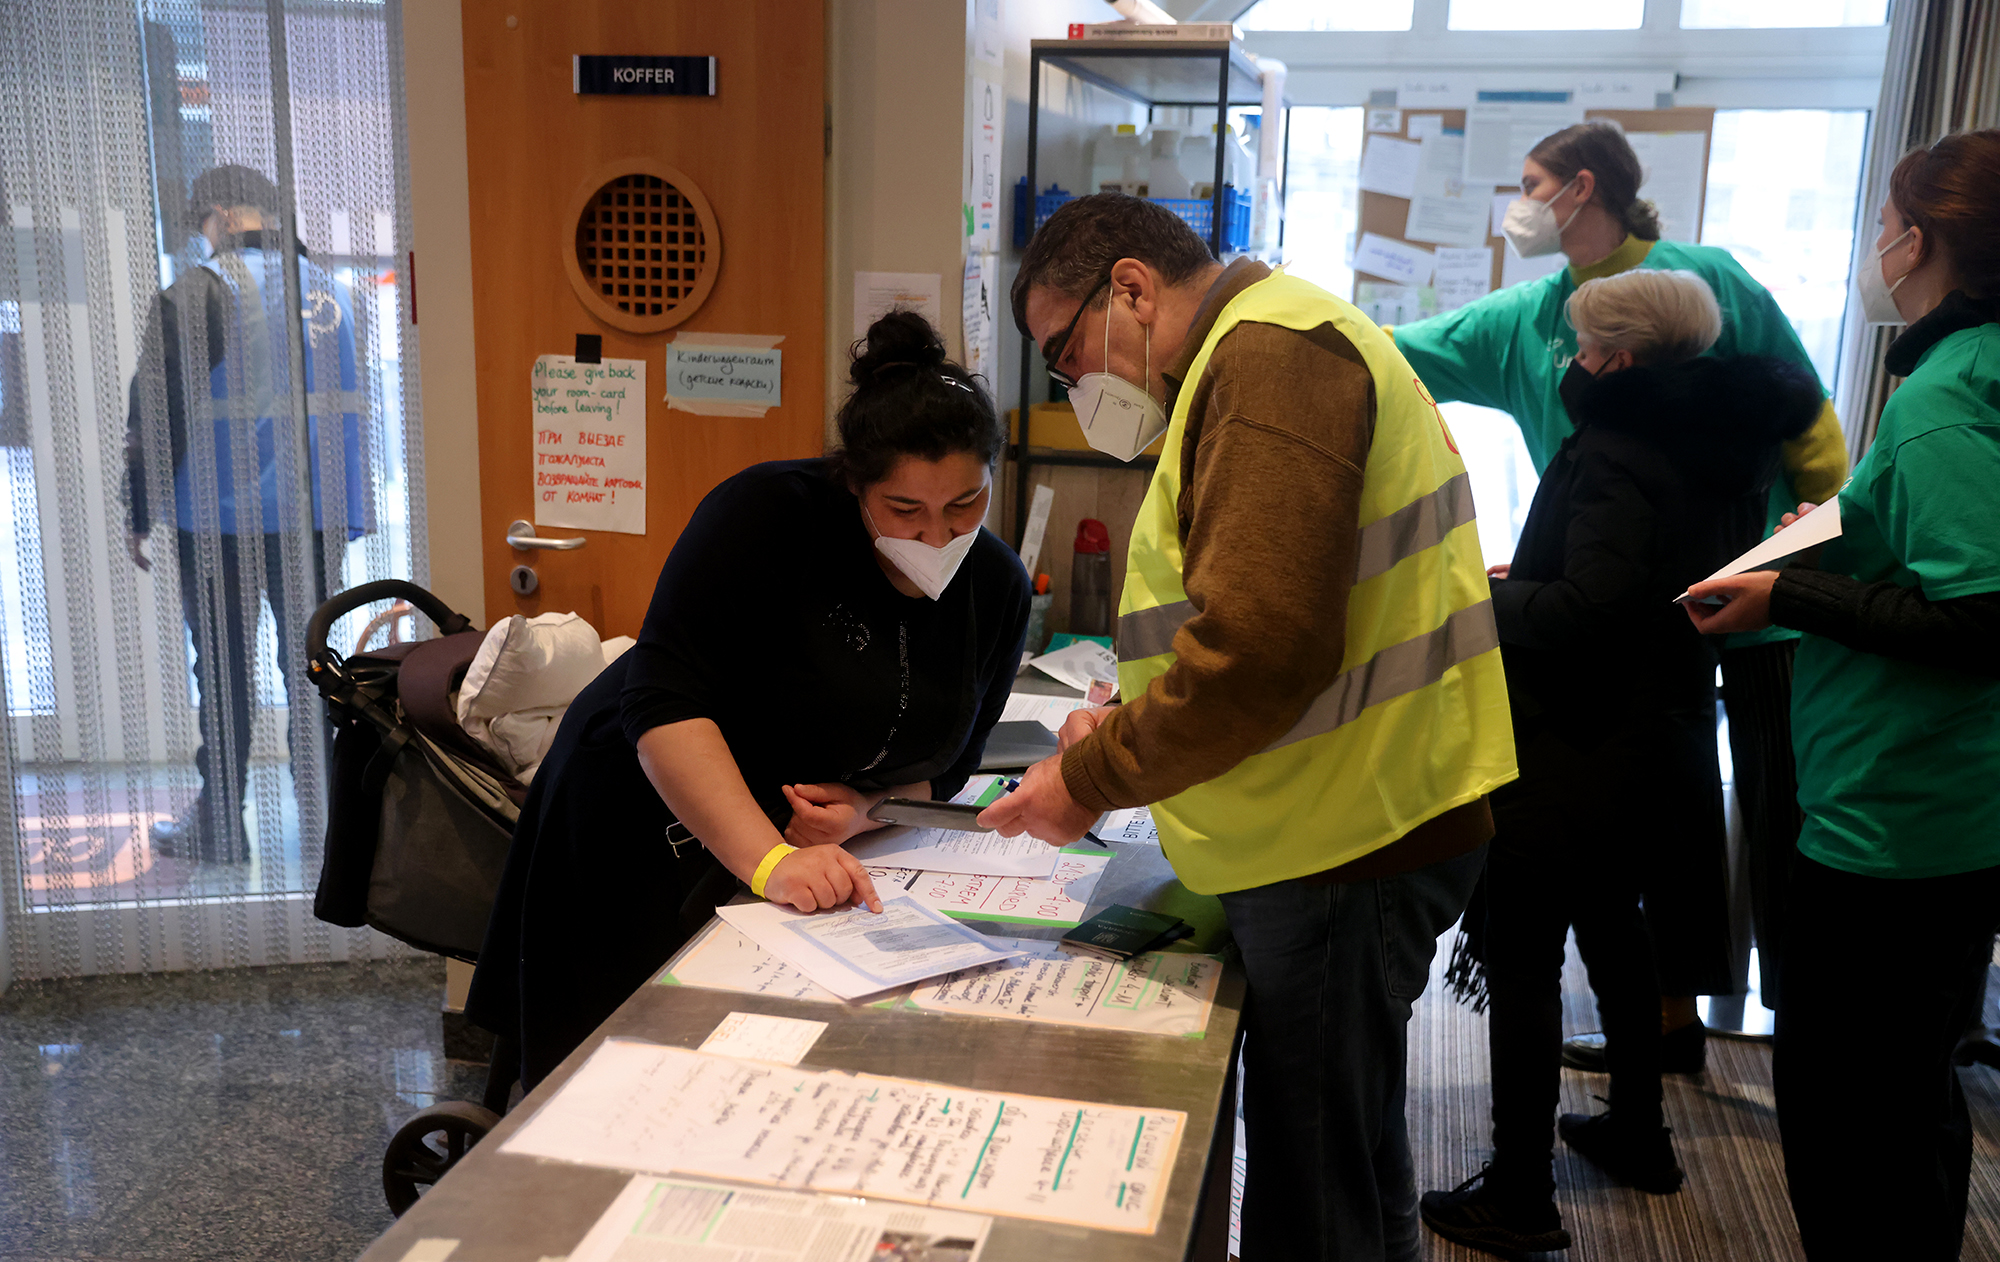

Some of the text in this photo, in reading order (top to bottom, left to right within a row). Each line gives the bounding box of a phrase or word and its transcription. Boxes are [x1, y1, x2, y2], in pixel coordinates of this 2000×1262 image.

[614, 68, 674, 84] KOFFER
[677, 351, 774, 375] Kinderwagenraum
[535, 362, 636, 386] Please give back
[533, 388, 558, 401] your
[538, 400, 569, 415] before
[538, 430, 625, 447] ПРИ ВЫЕЗДЕ
[542, 491, 558, 502] ОТ
[1123, 820, 1145, 838] BITTE
[1085, 962, 1102, 977] public
